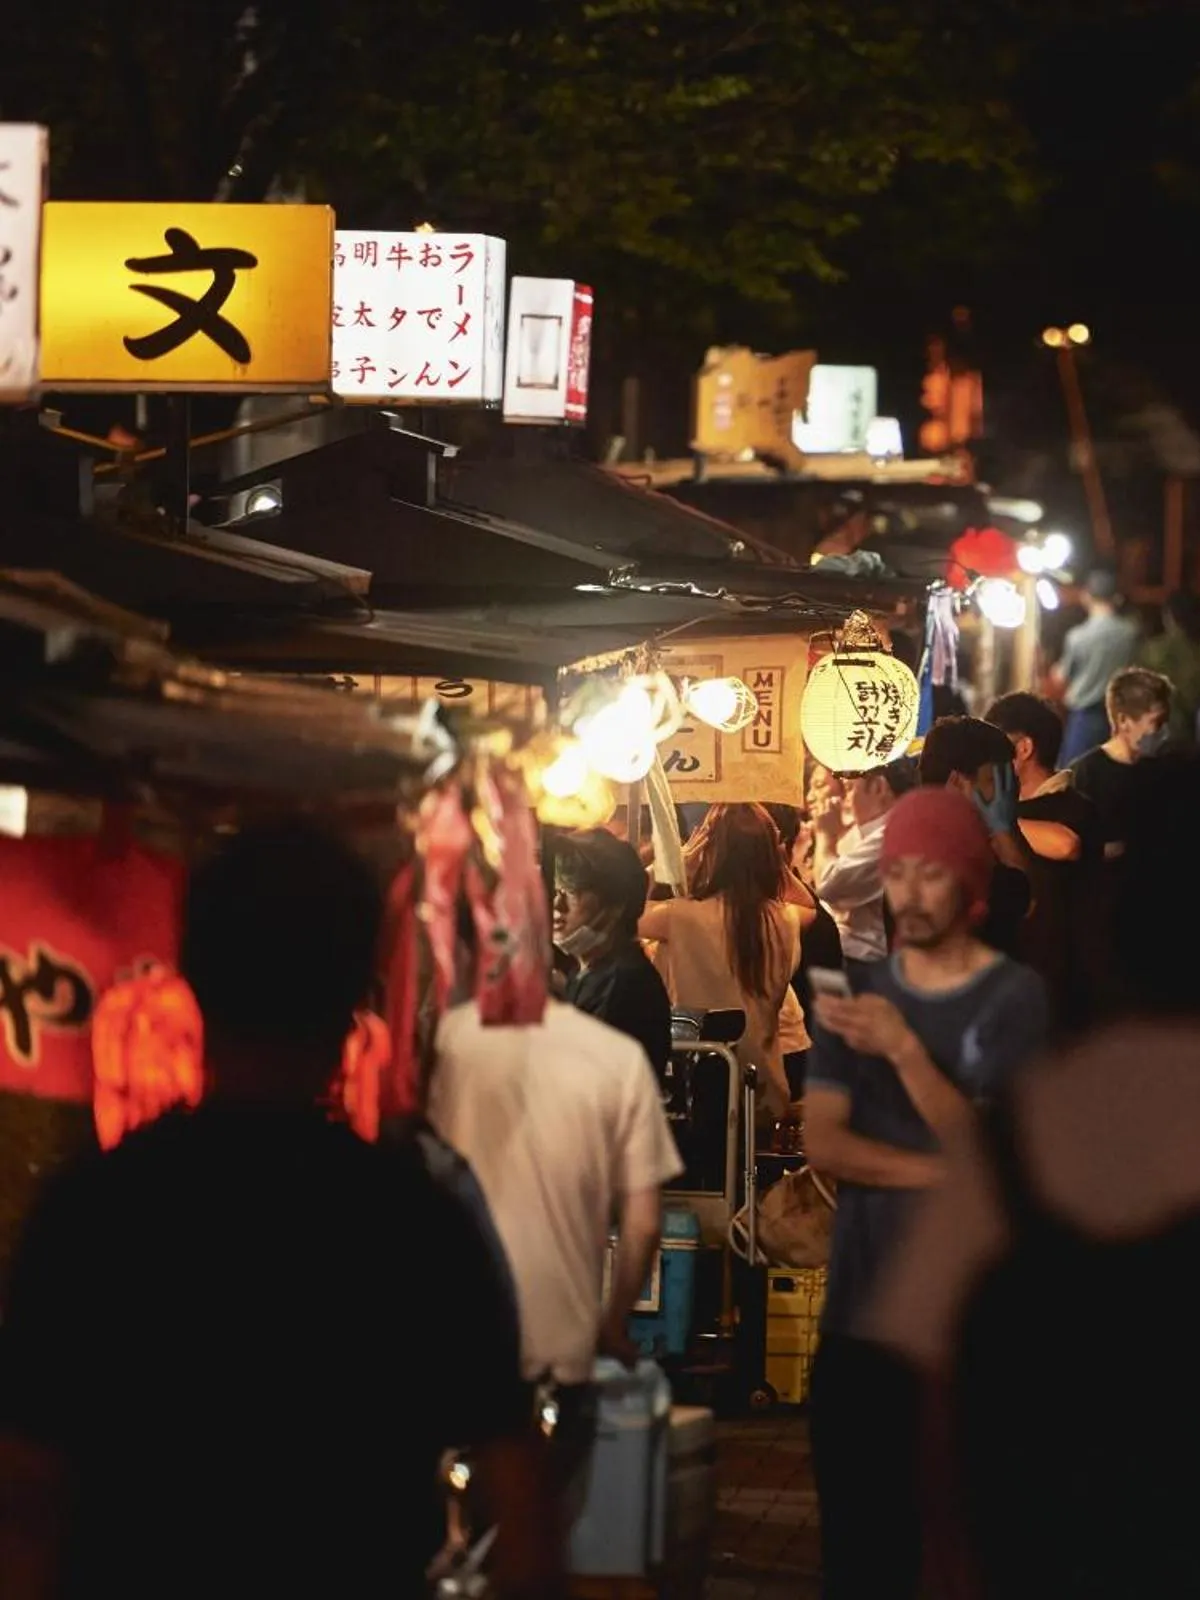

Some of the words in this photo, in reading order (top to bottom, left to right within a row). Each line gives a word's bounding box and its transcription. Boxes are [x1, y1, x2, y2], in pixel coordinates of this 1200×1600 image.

[122, 227, 259, 363] 文
[350, 240, 379, 385] 明太子
[386, 241, 413, 389] 牛タン
[413, 243, 444, 387] おでん
[447, 243, 475, 388] ラーメン
[752, 671, 774, 747] MENU
